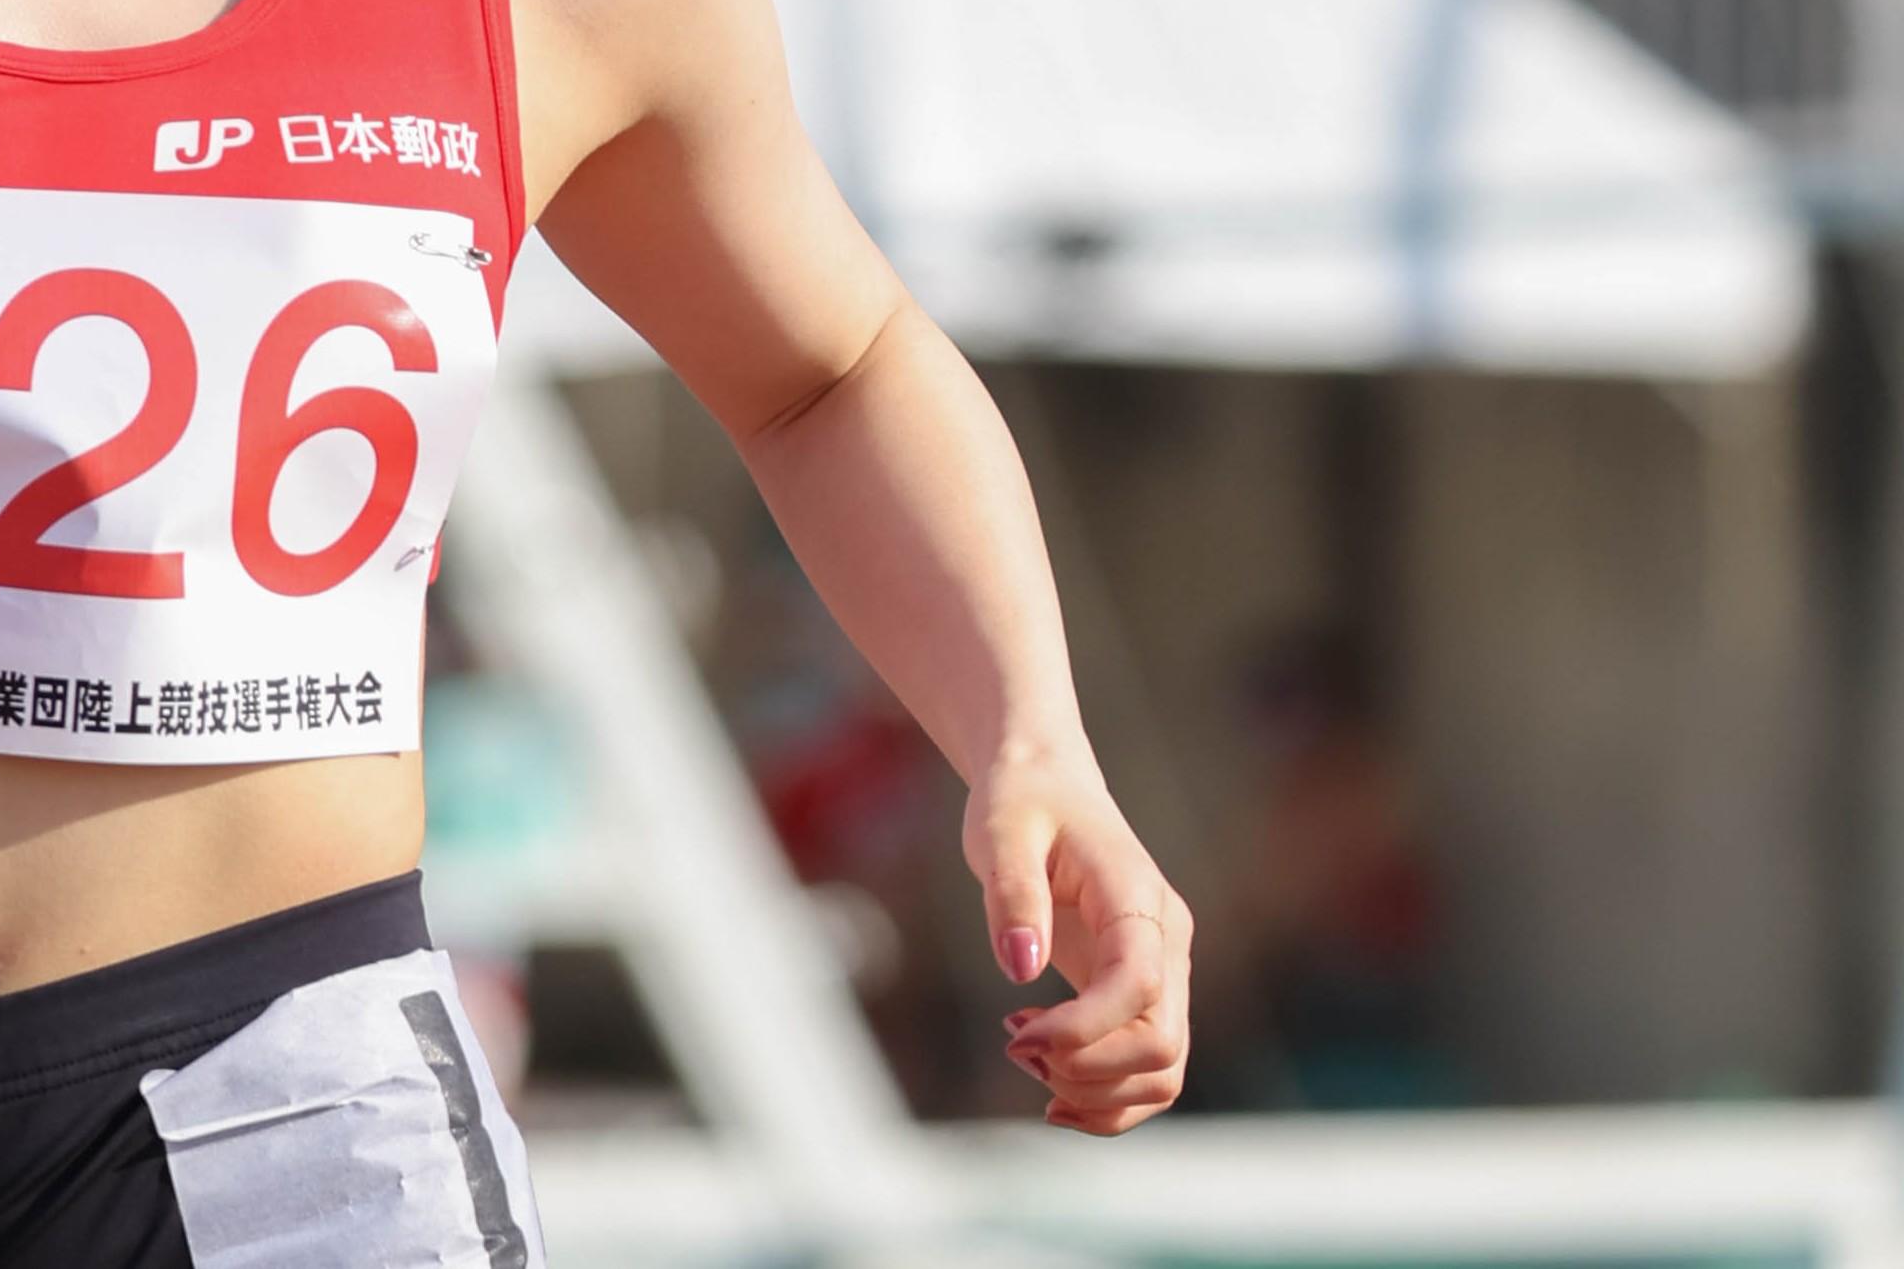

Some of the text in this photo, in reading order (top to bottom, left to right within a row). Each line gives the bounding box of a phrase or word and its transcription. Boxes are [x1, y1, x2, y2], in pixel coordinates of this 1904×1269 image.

[154, 113, 481, 177] JP 日本郵政
